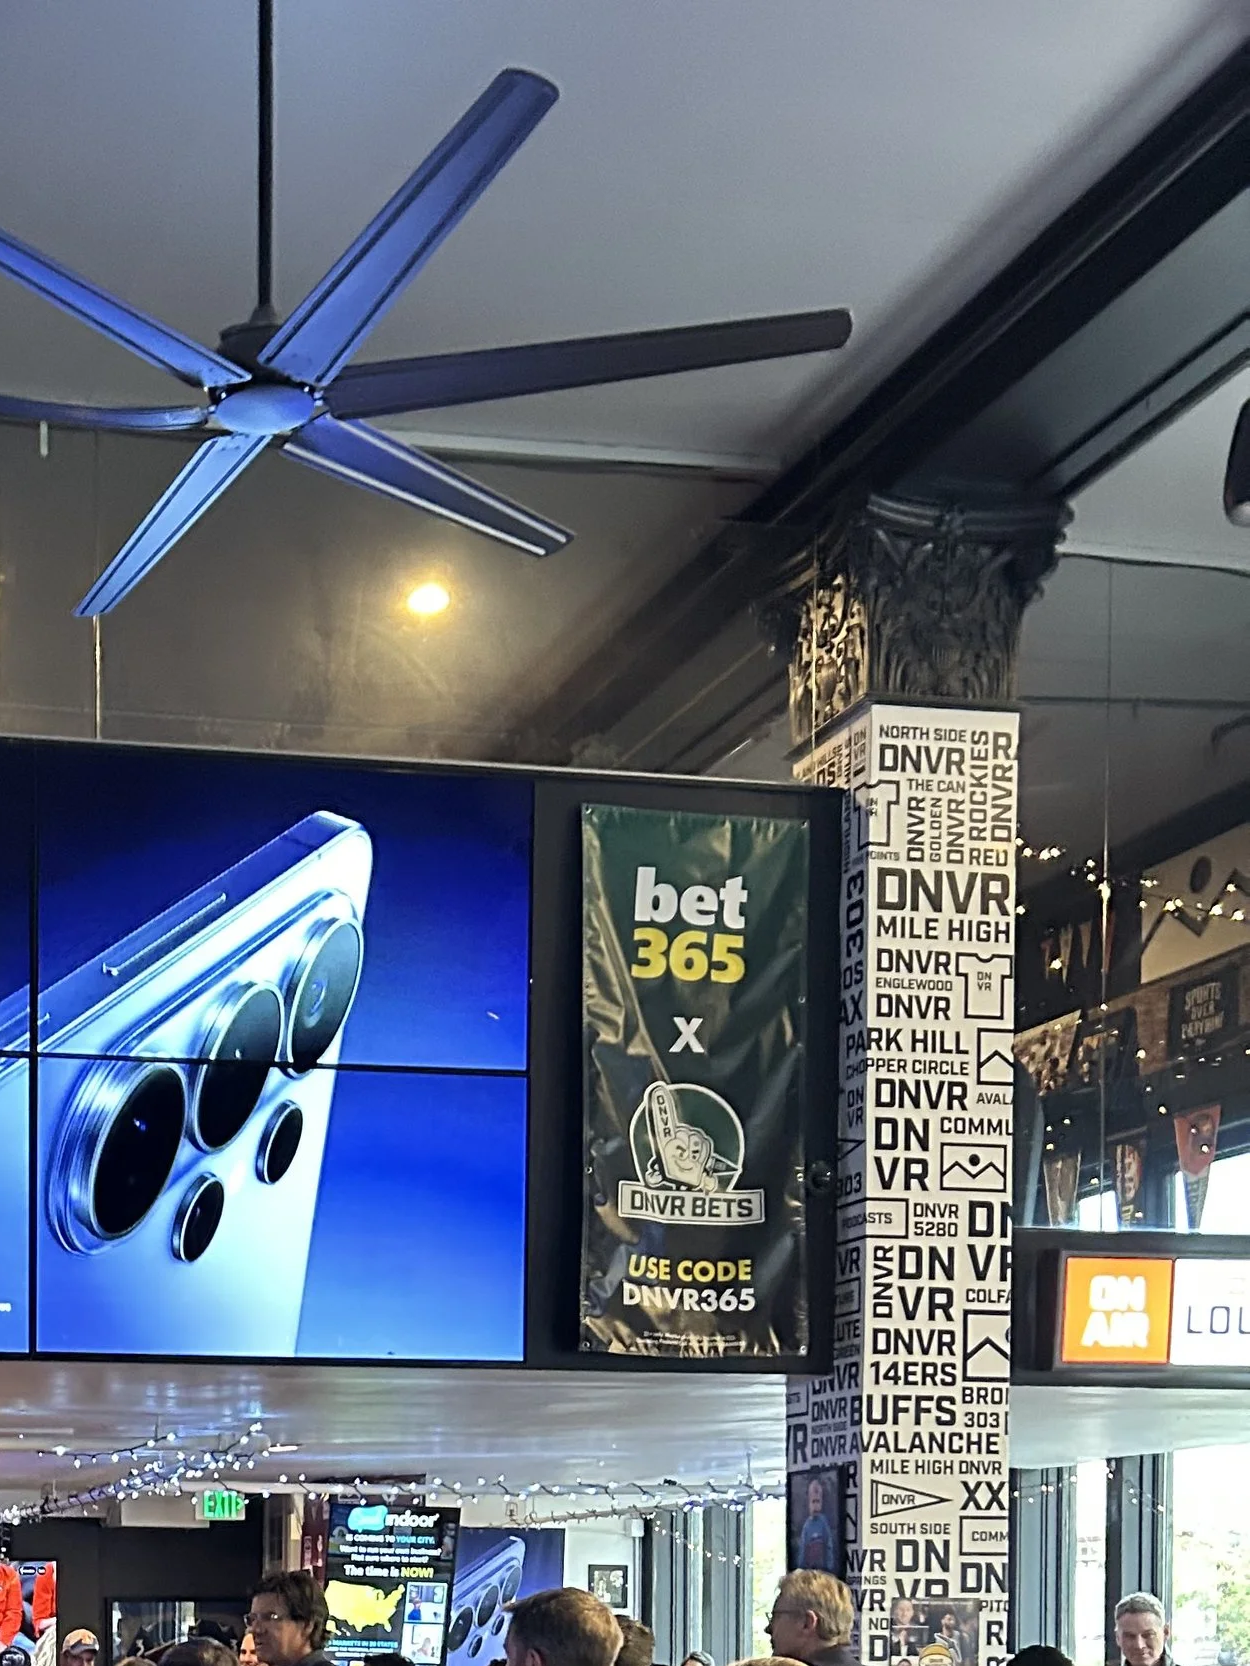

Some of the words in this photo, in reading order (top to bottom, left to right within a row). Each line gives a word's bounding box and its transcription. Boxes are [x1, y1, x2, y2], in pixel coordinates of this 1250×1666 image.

[879, 724, 930, 740] NORTH
[933, 727, 967, 743] SIDE
[878, 743, 966, 776] DNVR
[906, 778, 933, 792] THE
[937, 779, 966, 793] CAN
[969, 730, 989, 842] ROCKIES
[906, 796, 926, 862] DNVR
[929, 797, 942, 863] GOLDEN
[946, 798, 965, 864] DNVR
[969, 847, 1008, 867] RED
[634, 866, 748, 929] bet
[877, 867, 1011, 917] DNVR
[876, 915, 939, 940] MILE
[948, 918, 1011, 943] HIGH
[631, 927, 746, 983] 365
[876, 948, 951, 975] DNVR
[875, 977, 953, 991] ENGLEWOOD
[876, 993, 951, 1020] DNVR
[911, 1029, 969, 1054] HILL
[912, 1059, 969, 1076] CIRCLE
[875, 1078, 968, 1111] DNVR
[874, 1117, 930, 1151] DN
[873, 1156, 930, 1191] VR
[630, 1190, 685, 1216] DNVR
[691, 1195, 753, 1218] BETS
[913, 1203, 959, 1219] DNVR
[913, 1222, 959, 1237] 5280
[628, 1254, 671, 1280] USE
[676, 1259, 752, 1283] CODE
[898, 1245, 955, 1280] DN
[622, 1279, 756, 1312] DNVR365
[873, 1245, 894, 1318] DNVR
[1089, 1275, 1146, 1312] ON
[897, 1286, 955, 1321] VR
[872, 1328, 956, 1356] DNVR
[1081, 1311, 1150, 1348] AIR
[870, 1361, 956, 1386] 14ERS
[811, 1397, 847, 1422] DNVR
[850, 1394, 956, 1426] BUFFS
[964, 1412, 999, 1428] 303
[811, 1434, 847, 1459] DNVR
[849, 1431, 1000, 1455] AVALANCHE
[870, 1459, 912, 1474] MILE
[915, 1460, 953, 1475] HIGH
[959, 1460, 1002, 1475] DNVR
[204, 1490, 237, 1518] EXIT
[882, 1494, 915, 1505] DNVR
[870, 1523, 916, 1534] SOUTH
[920, 1523, 951, 1534] SIDE
[895, 1539, 950, 1573] DN
[344, 1564, 364, 1576] The
[365, 1565, 389, 1577] time
[401, 1567, 434, 1578] NOW!
